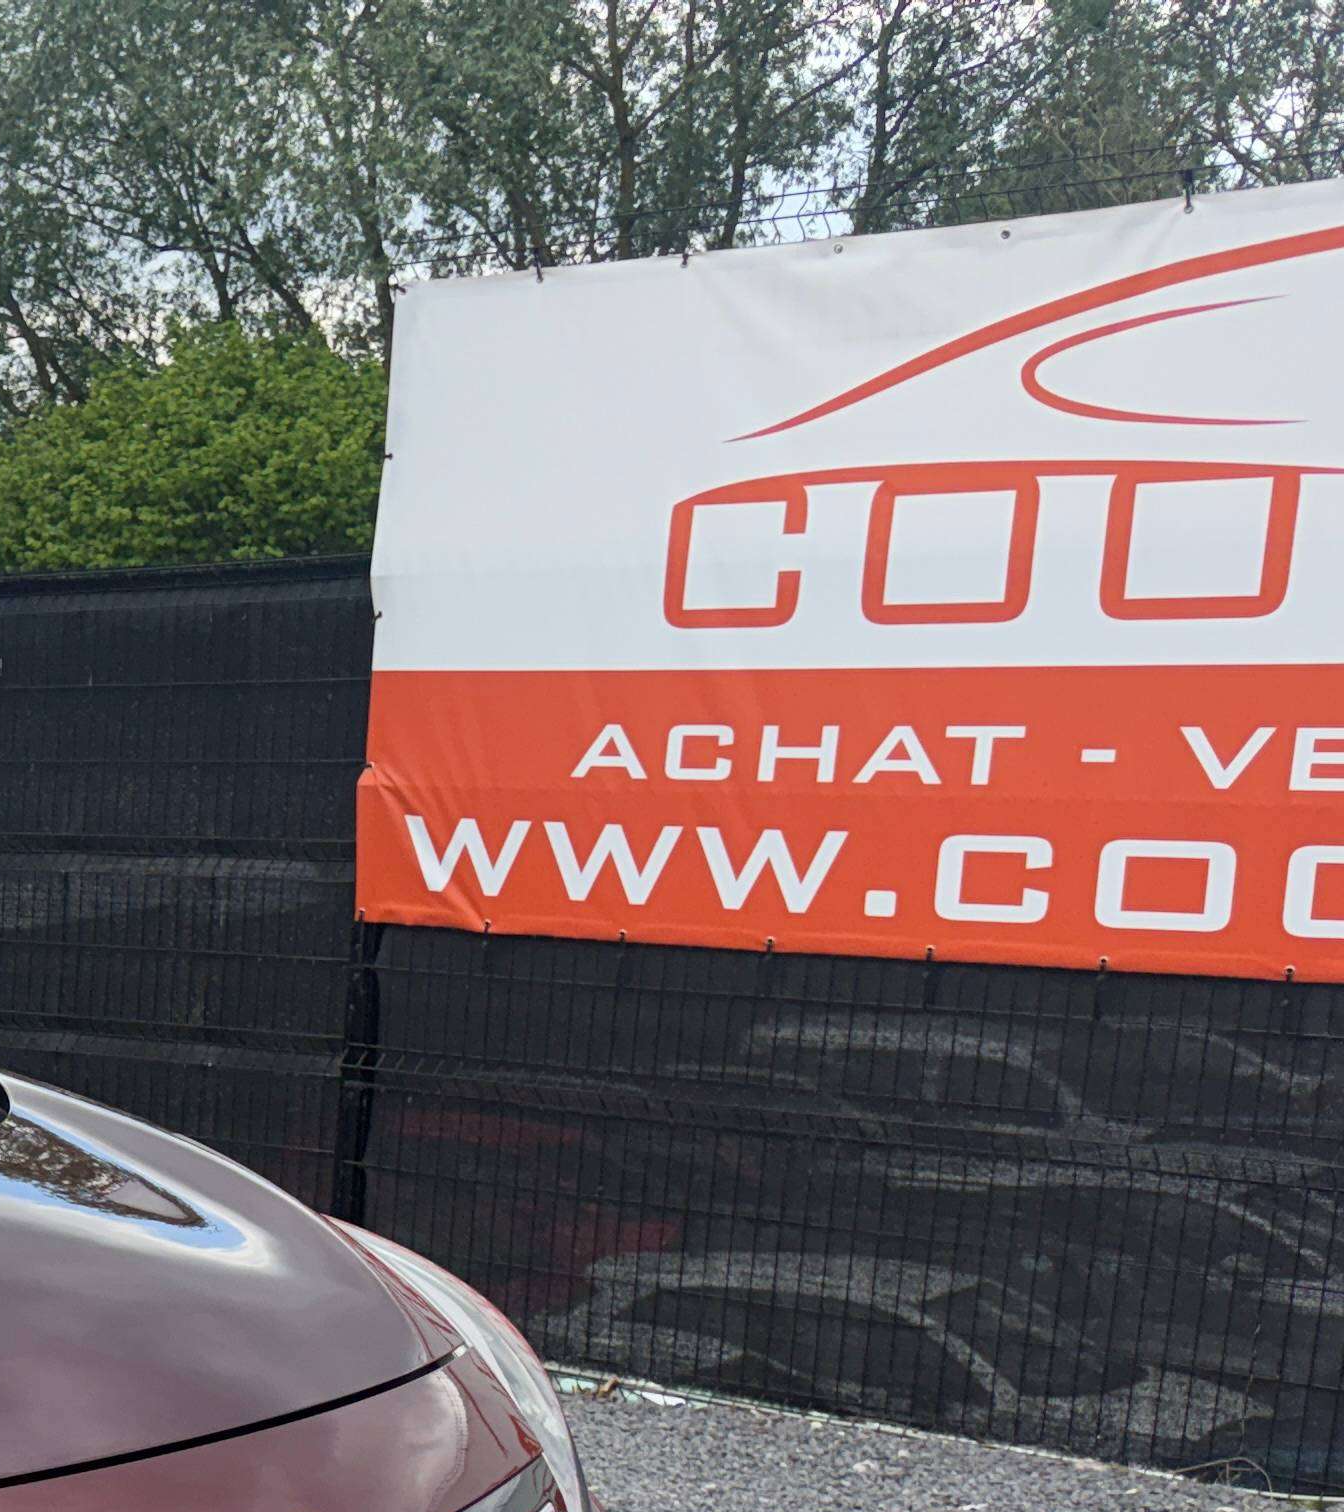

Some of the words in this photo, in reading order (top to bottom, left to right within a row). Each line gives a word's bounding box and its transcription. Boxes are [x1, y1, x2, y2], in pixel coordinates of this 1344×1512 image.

[570, 723, 1027, 787] ACHAT
[1081, 748, 1117, 763] -
[1178, 725, 1344, 792] VE
